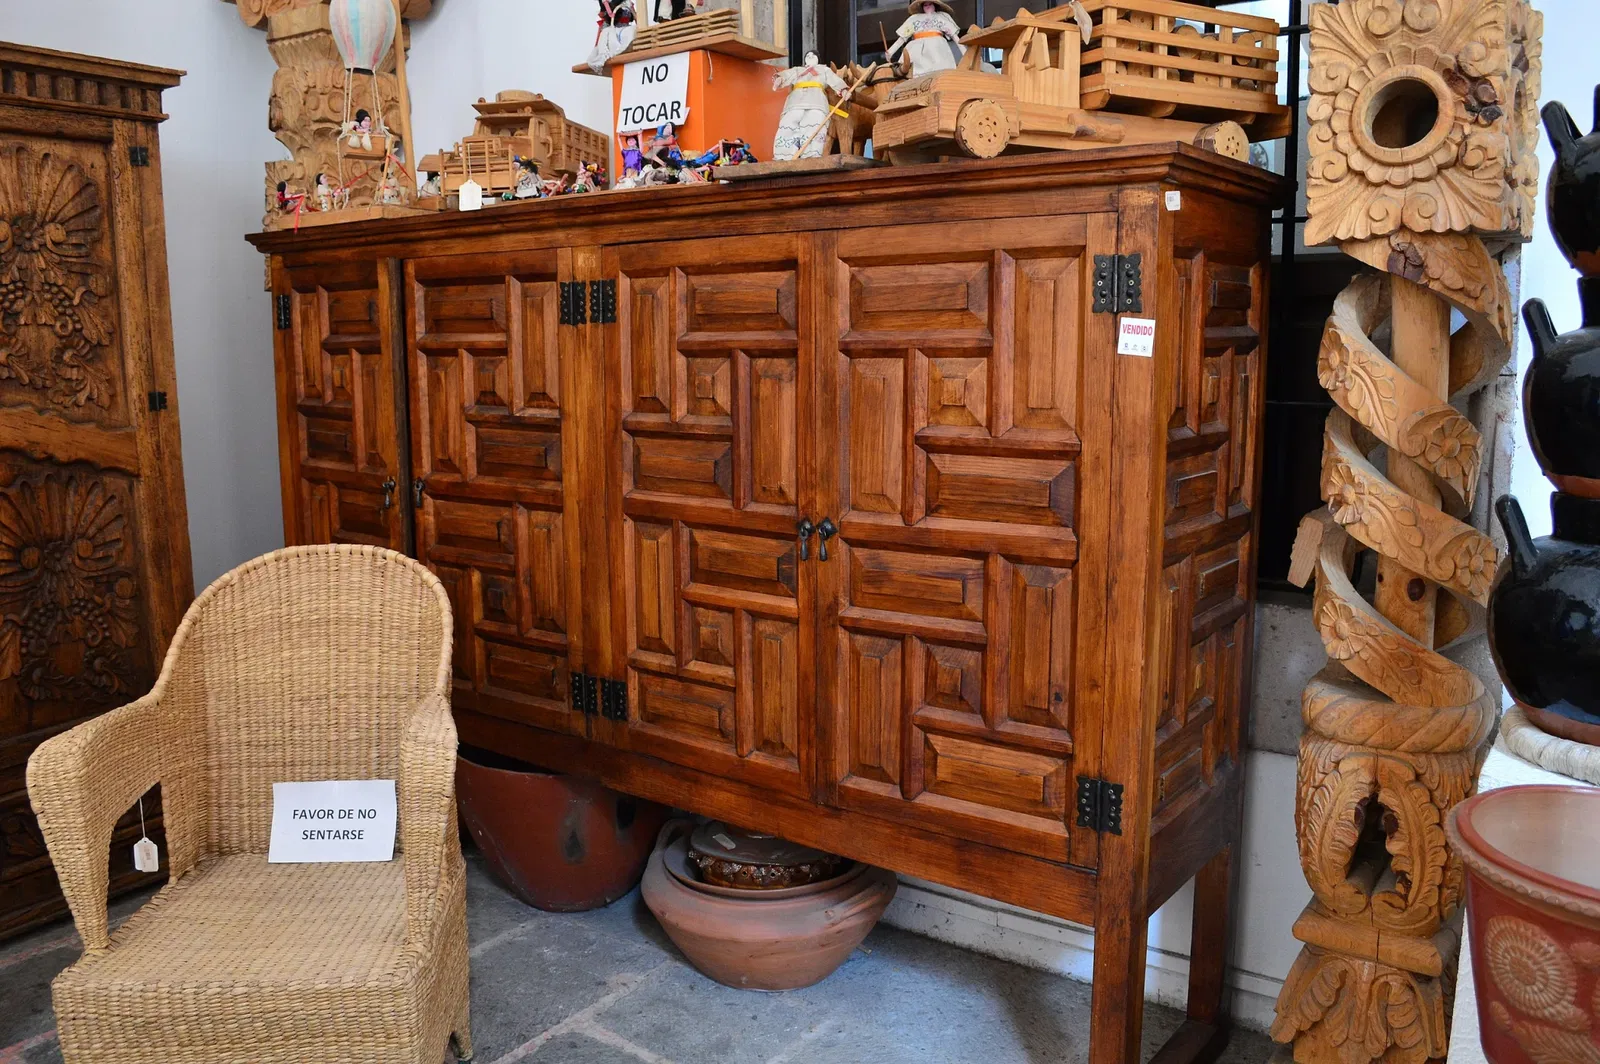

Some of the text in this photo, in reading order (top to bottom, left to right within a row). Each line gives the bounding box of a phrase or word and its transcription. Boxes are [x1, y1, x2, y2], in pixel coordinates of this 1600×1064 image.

[641, 63, 669, 85] NO
[622, 100, 682, 126] TOCAR
[1122, 323, 1153, 336] VENDIDO
[292, 808, 377, 820] FAVOR DE NO
[301, 829, 364, 841] SENTARSE
